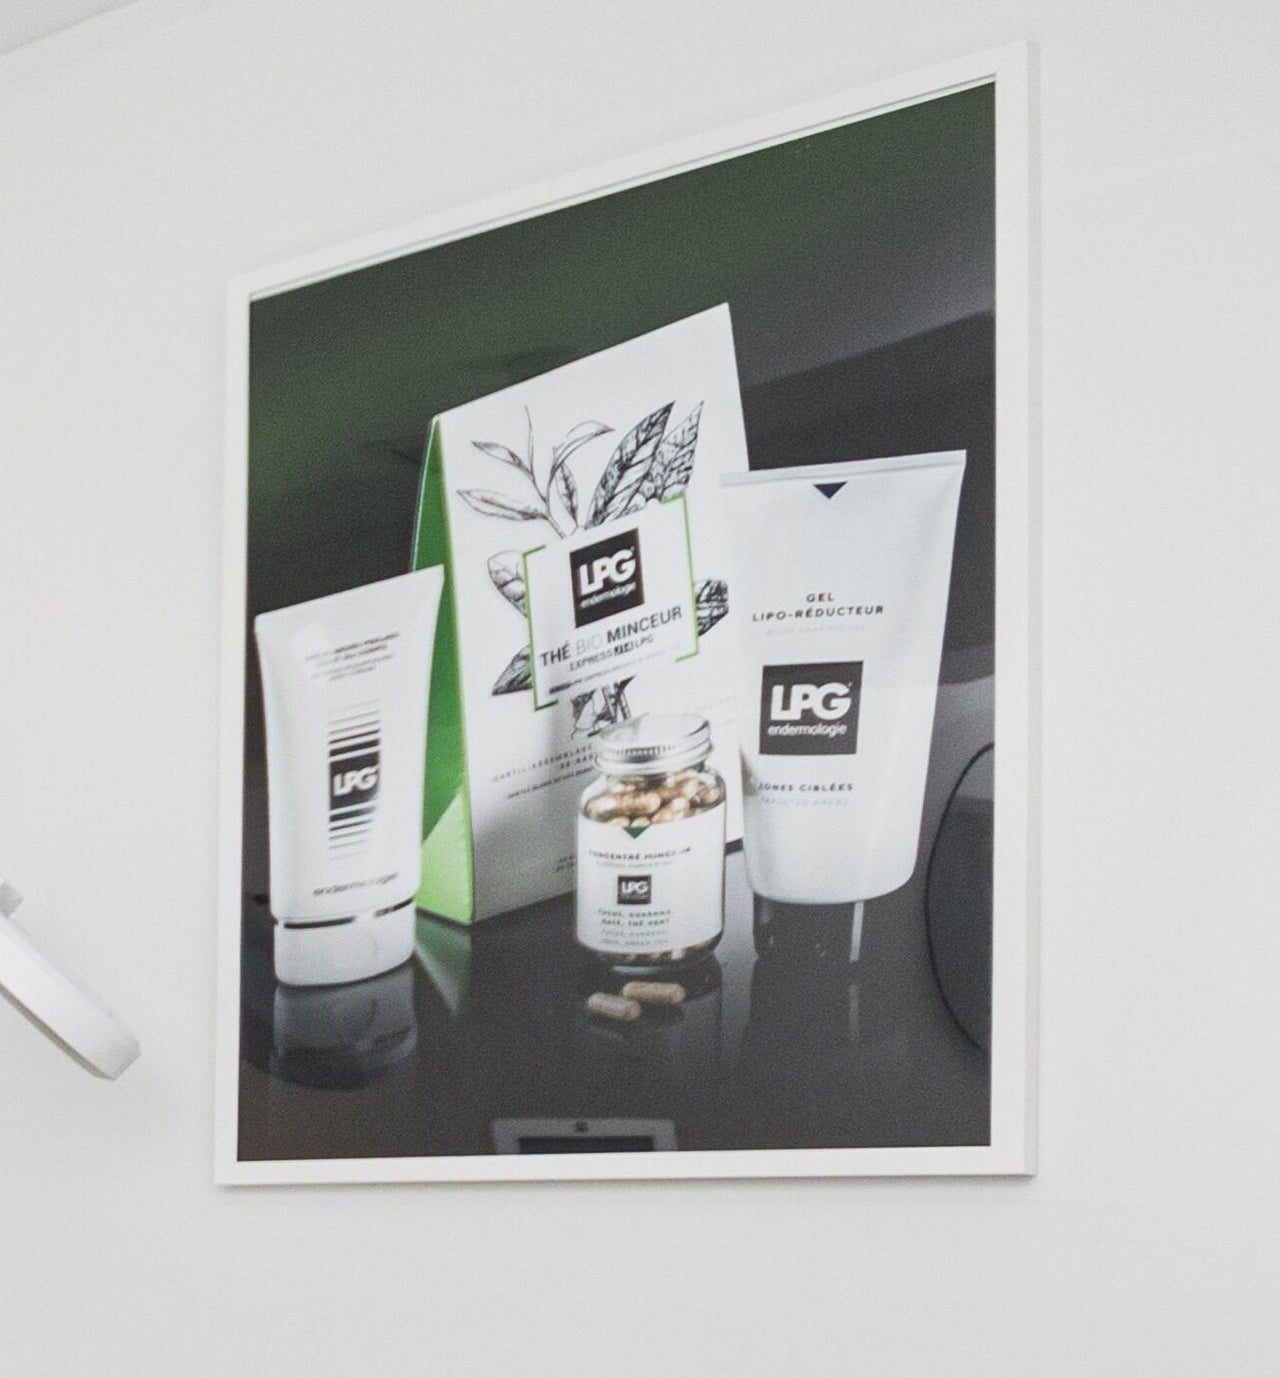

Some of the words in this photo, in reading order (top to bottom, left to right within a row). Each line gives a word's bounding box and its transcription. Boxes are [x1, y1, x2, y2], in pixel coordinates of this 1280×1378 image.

[578, 546, 637, 596] LPG
[806, 592, 834, 603] GEL
[752, 605, 884, 622] LIPO-RÉDUCTEUR
[540, 640, 572, 667] THÉ
[607, 605, 683, 643] MINCEUR
[770, 682, 852, 721] LPG
[767, 722, 848, 738] endermologie
[333, 765, 378, 798] LPG
[621, 880, 649, 895] LPG
